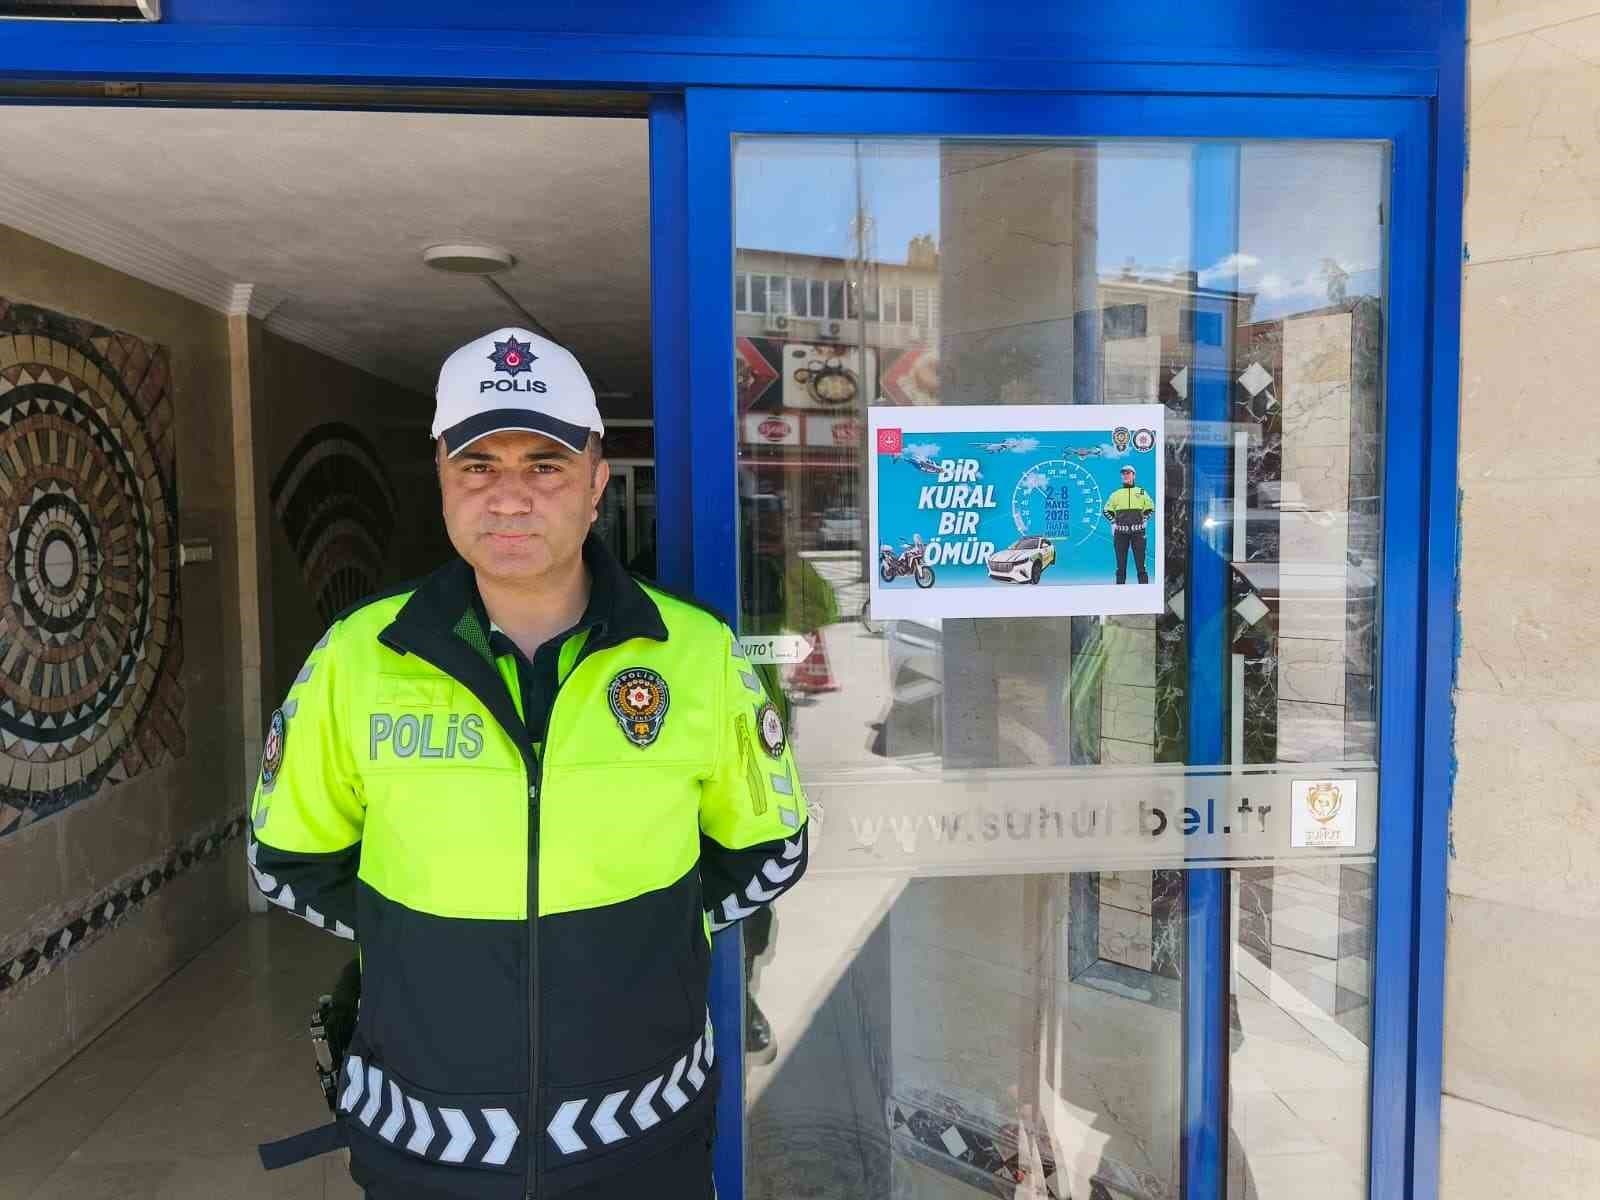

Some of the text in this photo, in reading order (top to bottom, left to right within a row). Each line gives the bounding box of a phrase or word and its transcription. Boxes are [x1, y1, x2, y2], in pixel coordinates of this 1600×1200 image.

[917, 484, 998, 509] KURAL
[923, 536, 995, 567] ÖMÜR
[741, 644, 767, 656] UTO
